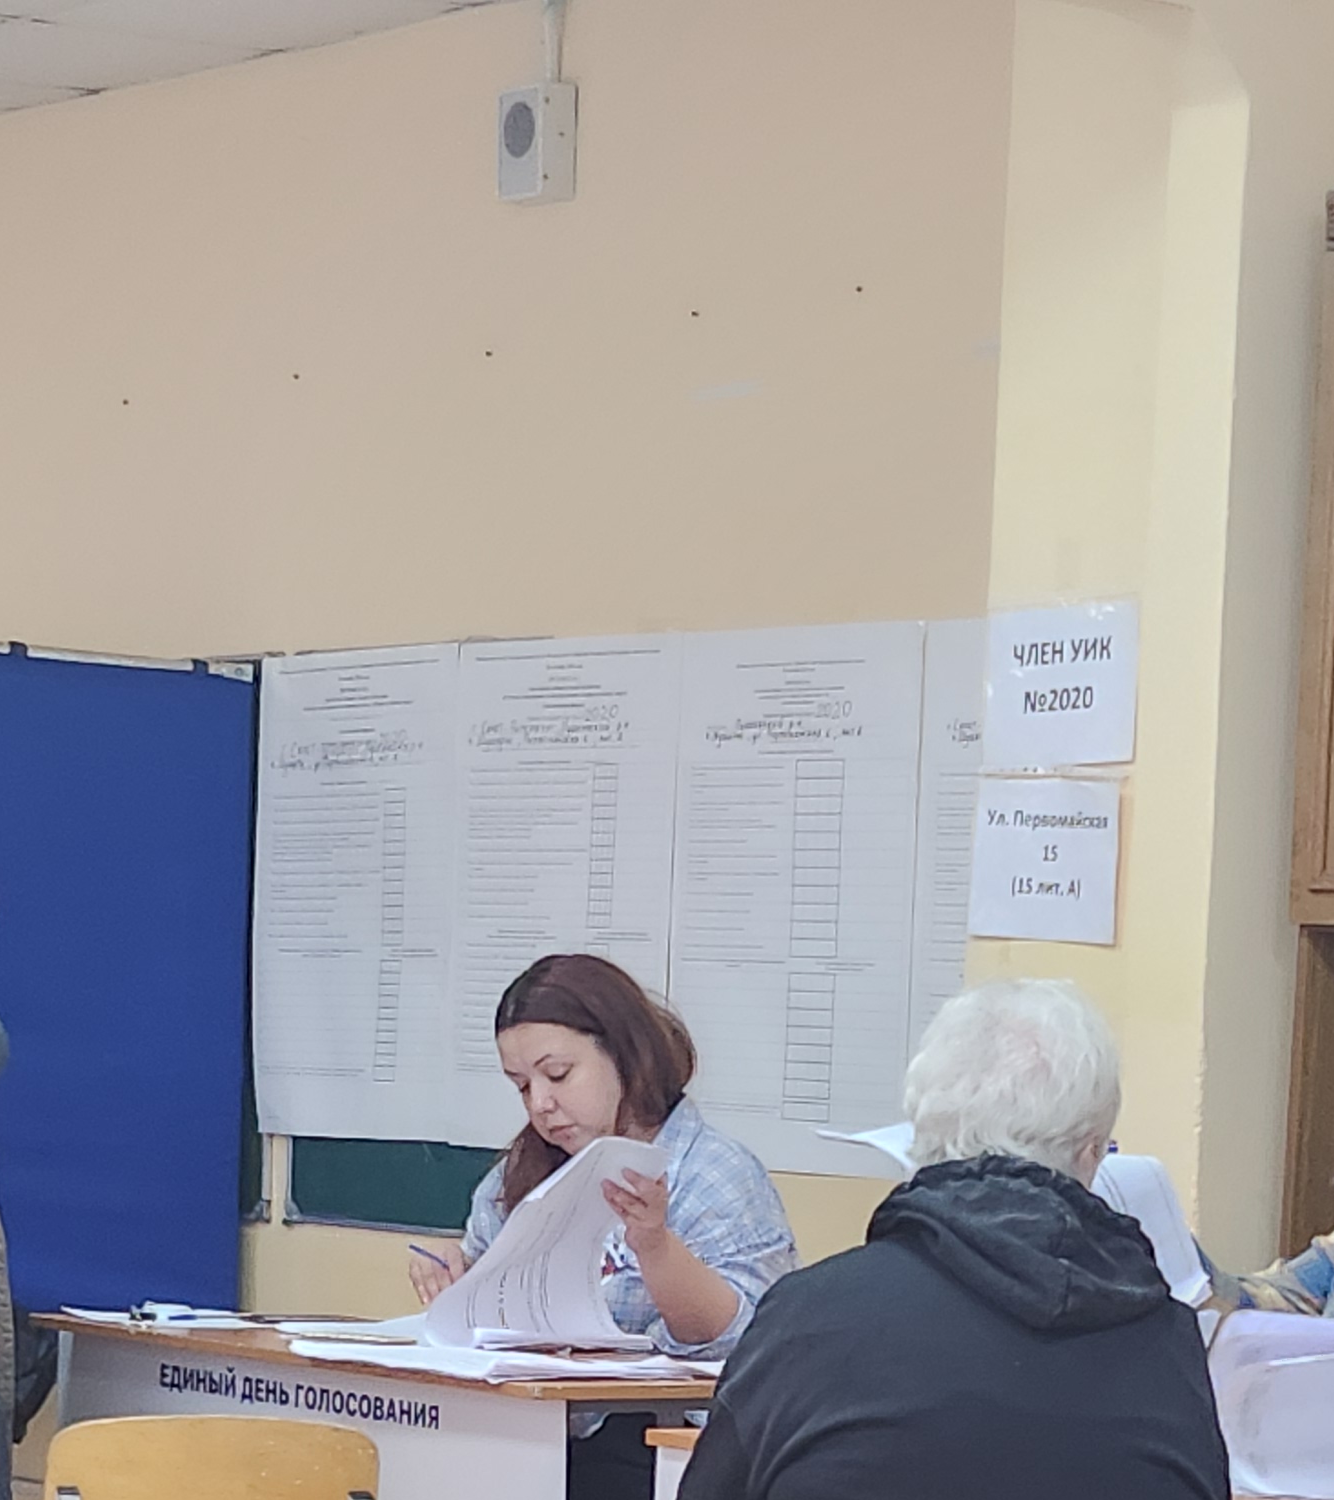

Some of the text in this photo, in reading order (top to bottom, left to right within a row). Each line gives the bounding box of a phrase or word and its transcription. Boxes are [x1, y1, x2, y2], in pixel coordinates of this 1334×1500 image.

[1013, 635, 1113, 667] ЧЛЕН УИК
[1023, 686, 1095, 714] №2020
[987, 808, 1109, 831] Ул. Первомайская
[1042, 844, 1059, 862] 15
[1011, 876, 1033, 897] (15
[1067, 878, 1081, 900] А)
[159, 1362, 440, 1431] ЕДИНЫЙ ДЕНЬ ГОЛОСОВАНИЯ
